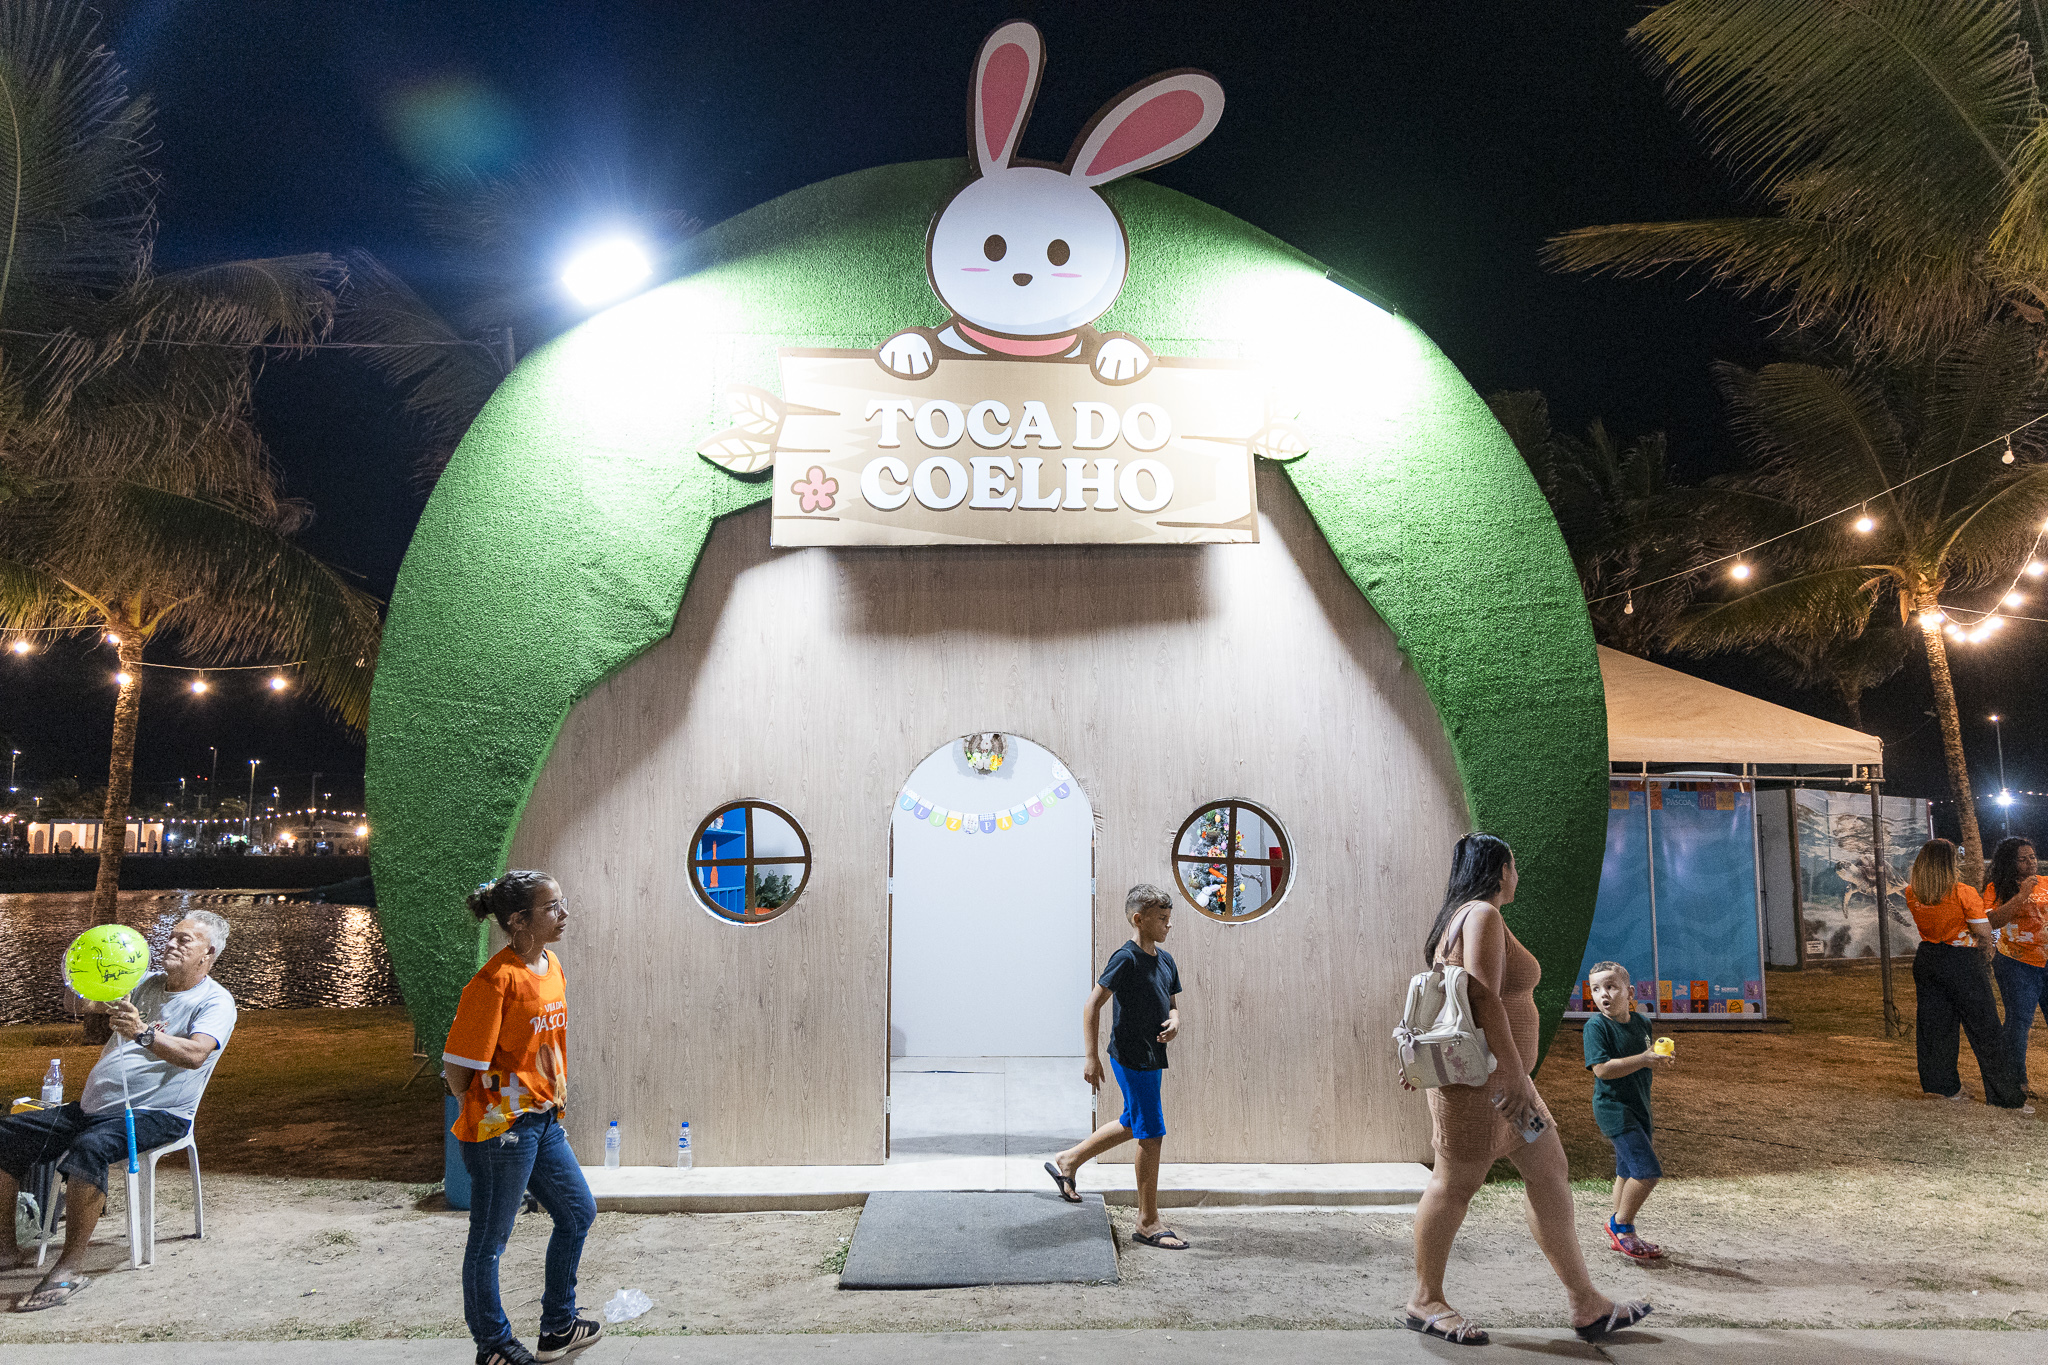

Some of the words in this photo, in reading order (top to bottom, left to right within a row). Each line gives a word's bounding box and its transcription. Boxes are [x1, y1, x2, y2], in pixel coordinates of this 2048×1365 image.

[865, 399, 1062, 450] TOCA
[1072, 401, 1172, 452] DO
[860, 455, 1174, 513] COELHO
[529, 1012, 568, 1036] PÁSCO
